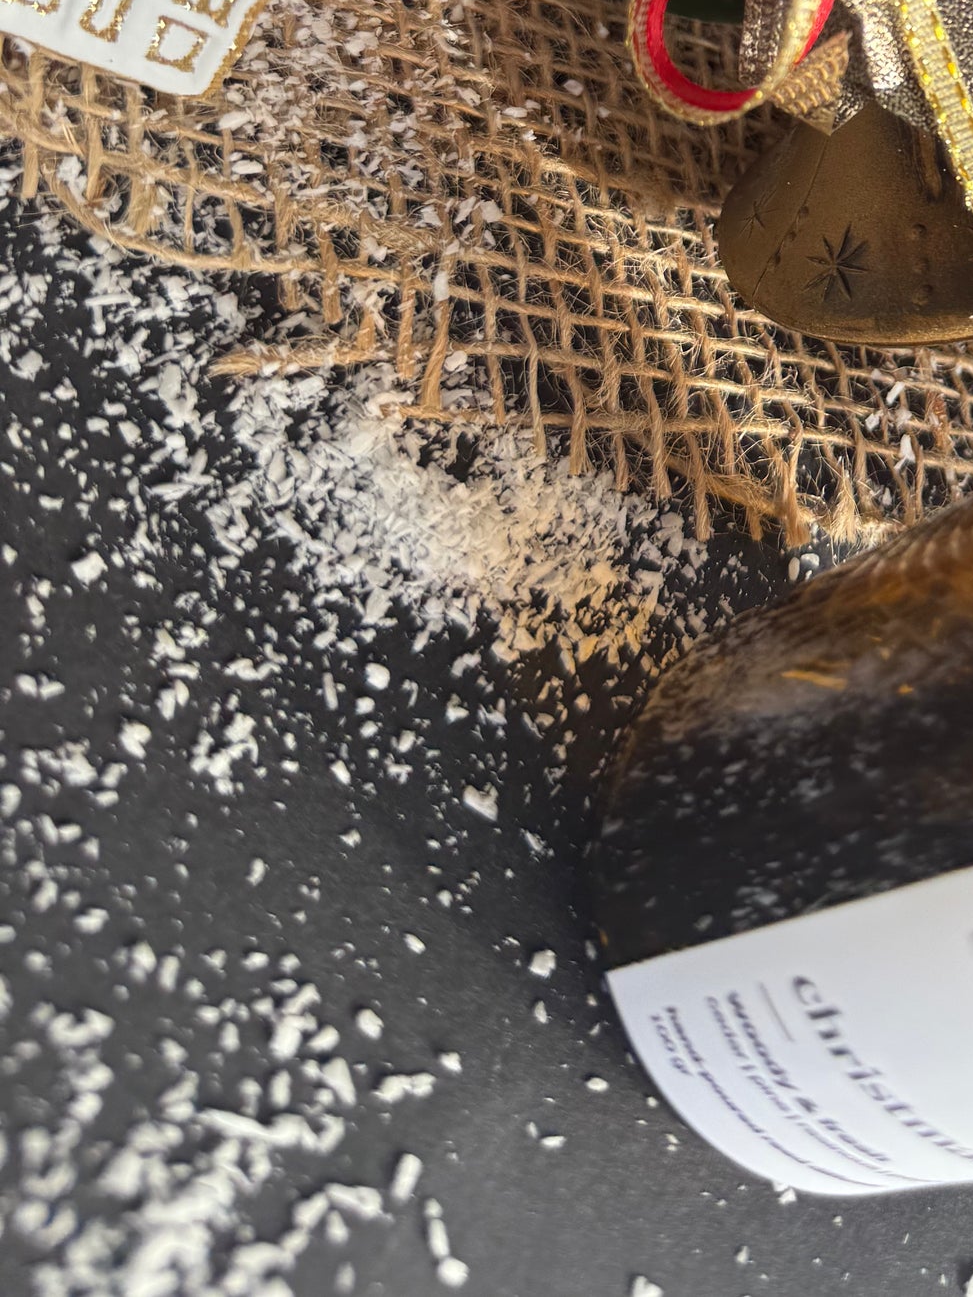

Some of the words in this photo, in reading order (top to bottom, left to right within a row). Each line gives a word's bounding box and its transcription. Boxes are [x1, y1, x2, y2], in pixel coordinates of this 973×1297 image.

[650, 1015, 677, 1052] 100
[670, 1056, 694, 1076] gr
[706, 995, 749, 1060] cedar
[727, 990, 800, 1091] woody
